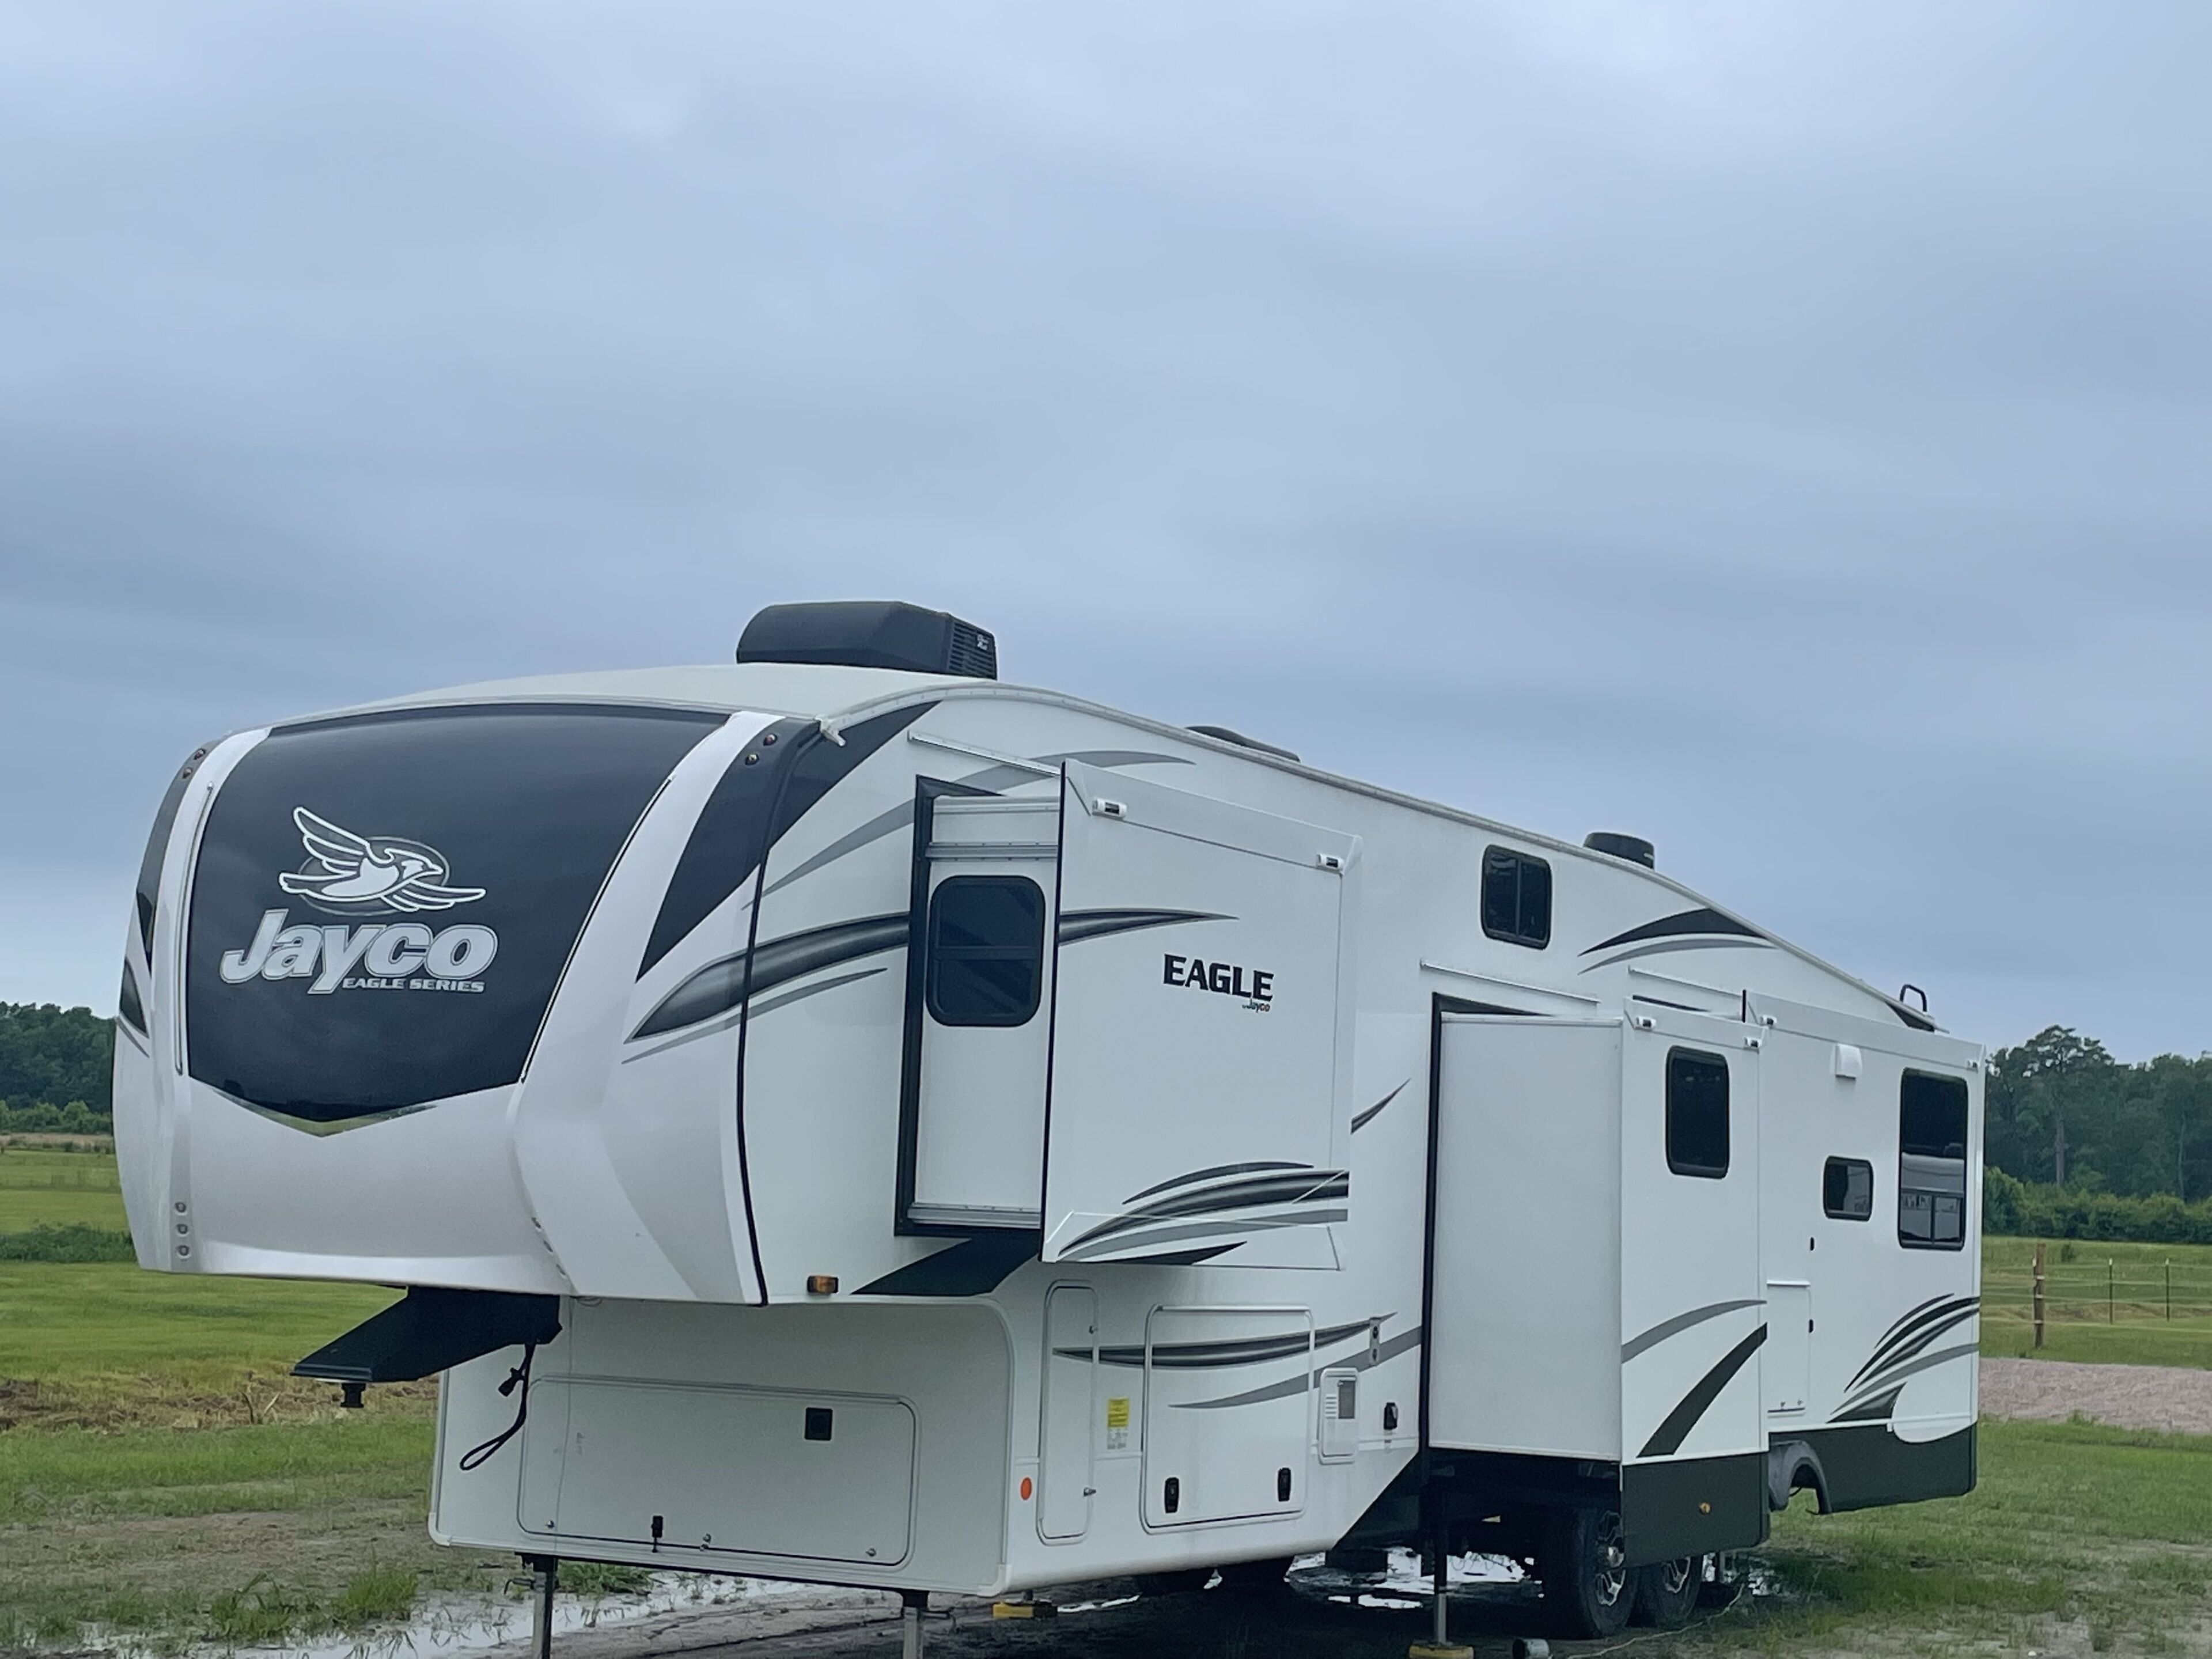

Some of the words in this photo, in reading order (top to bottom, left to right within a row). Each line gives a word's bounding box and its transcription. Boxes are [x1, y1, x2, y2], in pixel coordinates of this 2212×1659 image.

[220, 908, 498, 994] Jayco
[342, 978, 404, 989] EAGLE
[410, 979, 485, 993] SERIES
[1164, 953, 1274, 1002] EAGLE
